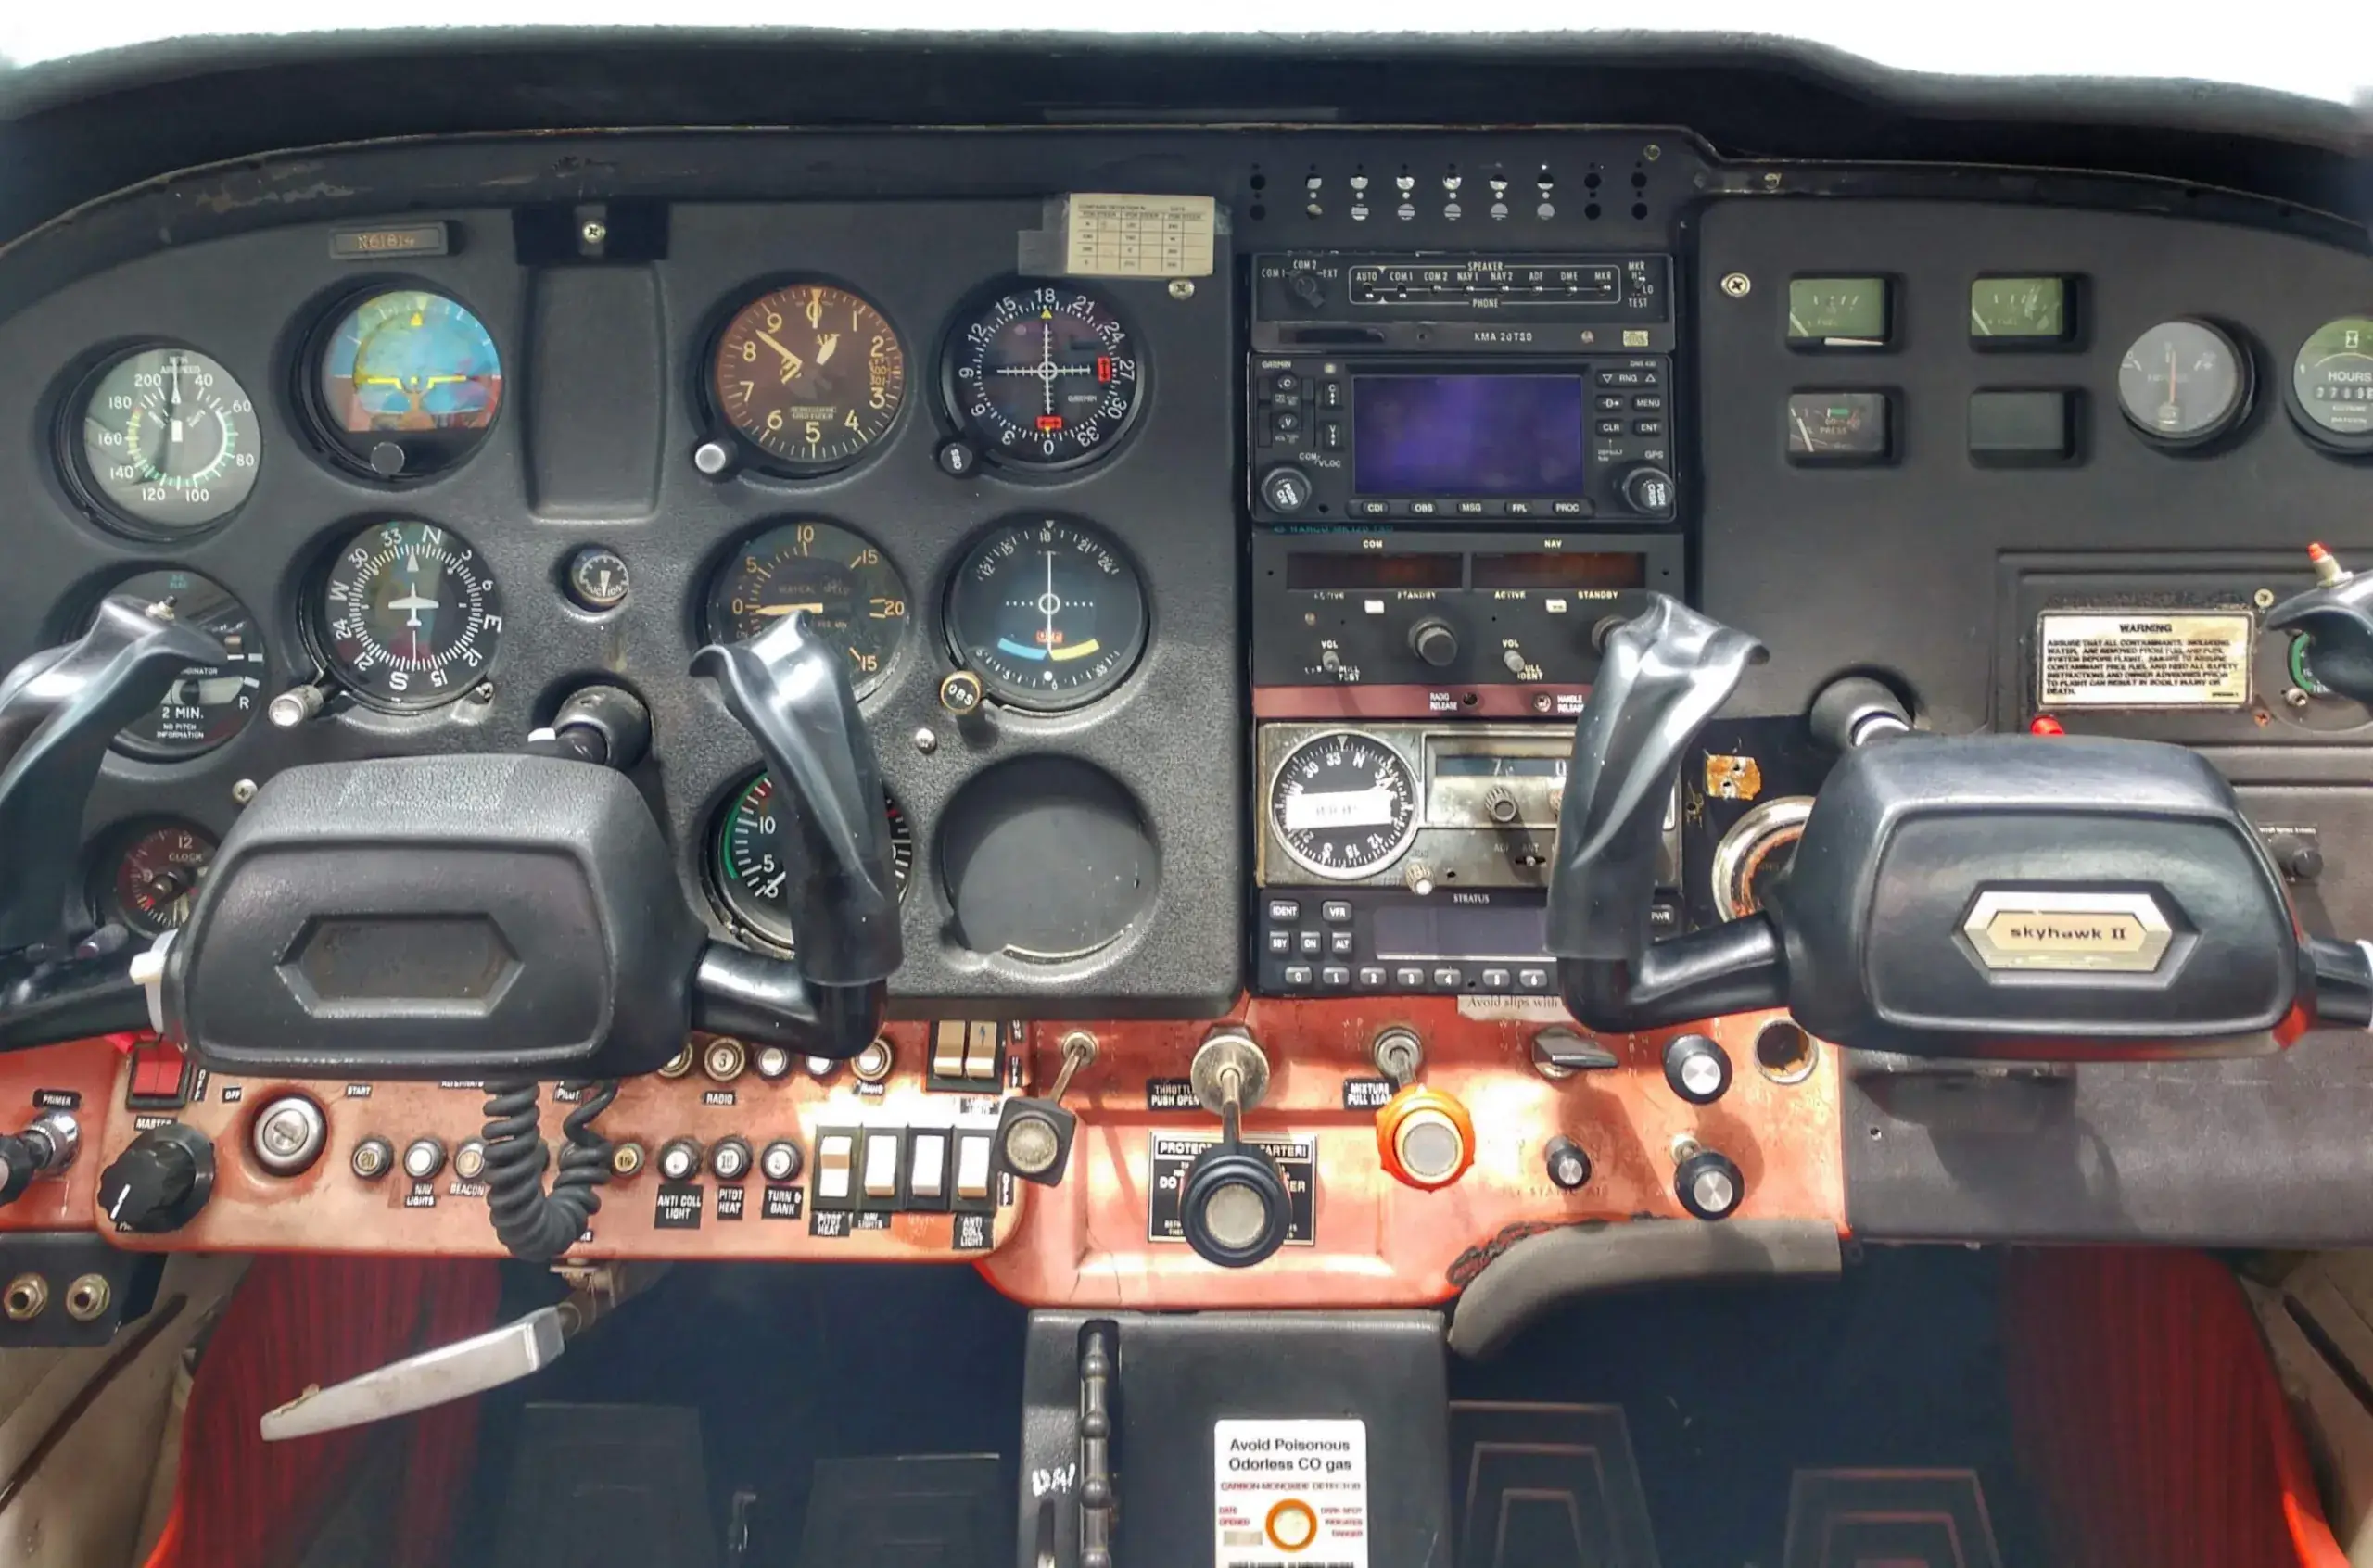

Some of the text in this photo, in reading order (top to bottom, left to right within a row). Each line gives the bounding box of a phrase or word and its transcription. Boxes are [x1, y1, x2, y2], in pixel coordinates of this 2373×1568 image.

[1468, 262, 1504, 271] SPEAKER
[1323, 269, 1338, 278] EXT
[1356, 272, 1377, 281] AUTO
[1390, 272, 1408, 281] COM
[1424, 272, 1441, 281] COM
[1457, 272, 1473, 281] NAV
[1491, 272, 1506, 281] NAV
[1035, 288, 1056, 303] 18
[995, 297, 1016, 315] 15
[1073, 296, 1095, 314] 21
[1472, 298, 1499, 308] PHONE
[1628, 298, 1647, 308] TEST
[767, 313, 782, 334] 9
[967, 323, 986, 343] 12
[1104, 322, 1125, 343] 24
[743, 341, 756, 362] 8
[871, 336, 883, 357] 2
[1119, 360, 1135, 381] 27
[2328, 371, 2372, 382] HOURS
[134, 374, 161, 387] 200
[195, 374, 213, 386] 40
[1619, 373, 1637, 383] RNG
[740, 381, 754, 402] 7
[108, 396, 132, 409] 180
[869, 387, 885, 409] 3
[1636, 398, 1660, 408] MENU
[233, 399, 252, 412] 60
[1108, 399, 1127, 420] 30
[767, 410, 783, 430] 6
[844, 410, 859, 431] 4
[806, 422, 820, 443] 5
[1603, 424, 1619, 432] CLR
[1641, 424, 1657, 432] ENT
[98, 432, 122, 445] 160
[1077, 426, 1099, 447] 33
[236, 454, 254, 466] 80
[1644, 450, 1664, 460] GPS
[110, 466, 133, 479] 140
[142, 488, 165, 501] 120
[185, 489, 209, 502] 100
[1367, 503, 1383, 512] CDI
[1415, 503, 1433, 512] OBS
[1462, 503, 1481, 512] MSG
[1512, 503, 1527, 512] FPL
[1555, 503, 1579, 512] PROC
[381, 528, 402, 547] 33
[422, 525, 442, 545] N
[797, 525, 814, 542] 10
[1363, 539, 1383, 549] COM
[1544, 539, 1562, 548] NAV
[348, 548, 368, 569] 30
[861, 550, 878, 564] 15
[746, 557, 757, 573] 5
[884, 601, 905, 615] 20
[333, 618, 352, 640] 24
[2120, 624, 2172, 633] WARNING
[1321, 640, 1338, 649] VOL
[1503, 639, 1519, 648] VOL
[354, 651, 374, 671] 21
[463, 648, 482, 667] 12
[860, 656, 877, 671] 15
[430, 668, 448, 688] 15
[947, 683, 974, 705] OBS
[239, 696, 249, 709] R
[162, 707, 204, 719] 2 MIN.
[759, 816, 776, 834] 10
[178, 836, 192, 849] 12
[169, 853, 202, 862] CLOCK
[763, 854, 775, 873] 5
[1453, 894, 1490, 904] STRATUS
[1273, 907, 1297, 917] IDENT
[1329, 908, 1346, 917] VFR
[1651, 911, 1669, 920] PWR
[2011, 927, 2126, 941] skyhawk II
[1273, 939, 1287, 948] SBY
[1304, 939, 1316, 948] ON
[1336, 940, 1349, 950] ALT
[1467, 997, 1557, 1009] Avoid slips with
[347, 1085, 371, 1095] START
[1350, 1082, 1390, 1094] MIXTURE
[43, 1094, 71, 1106] PRIMER
[224, 1090, 241, 1101] OFF
[706, 1093, 733, 1105] RADIO
[1151, 1094, 1175, 1106] PUSH
[1348, 1094, 1370, 1106] PULL
[1159, 1176, 1177, 1190] DO
[414, 1184, 432, 1195] NAV
[450, 1184, 485, 1195] BEACON
[718, 1188, 742, 1200] PITOT
[768, 1189, 792, 1201] TURN
[406, 1195, 434, 1207] LIGHTS
[658, 1195, 701, 1206] ANTI COLL
[718, 1201, 741, 1214] HEAT
[770, 1203, 795, 1215] BANK
[666, 1208, 691, 1220] LIGHT
[963, 1217, 983, 1226] ANTI
[817, 1225, 840, 1235] HEAT
[960, 1235, 983, 1247] LIGHT
[1230, 1438, 1351, 1451] Avoid Poisonous
[1229, 1458, 1351, 1473] Odorless CO gas
